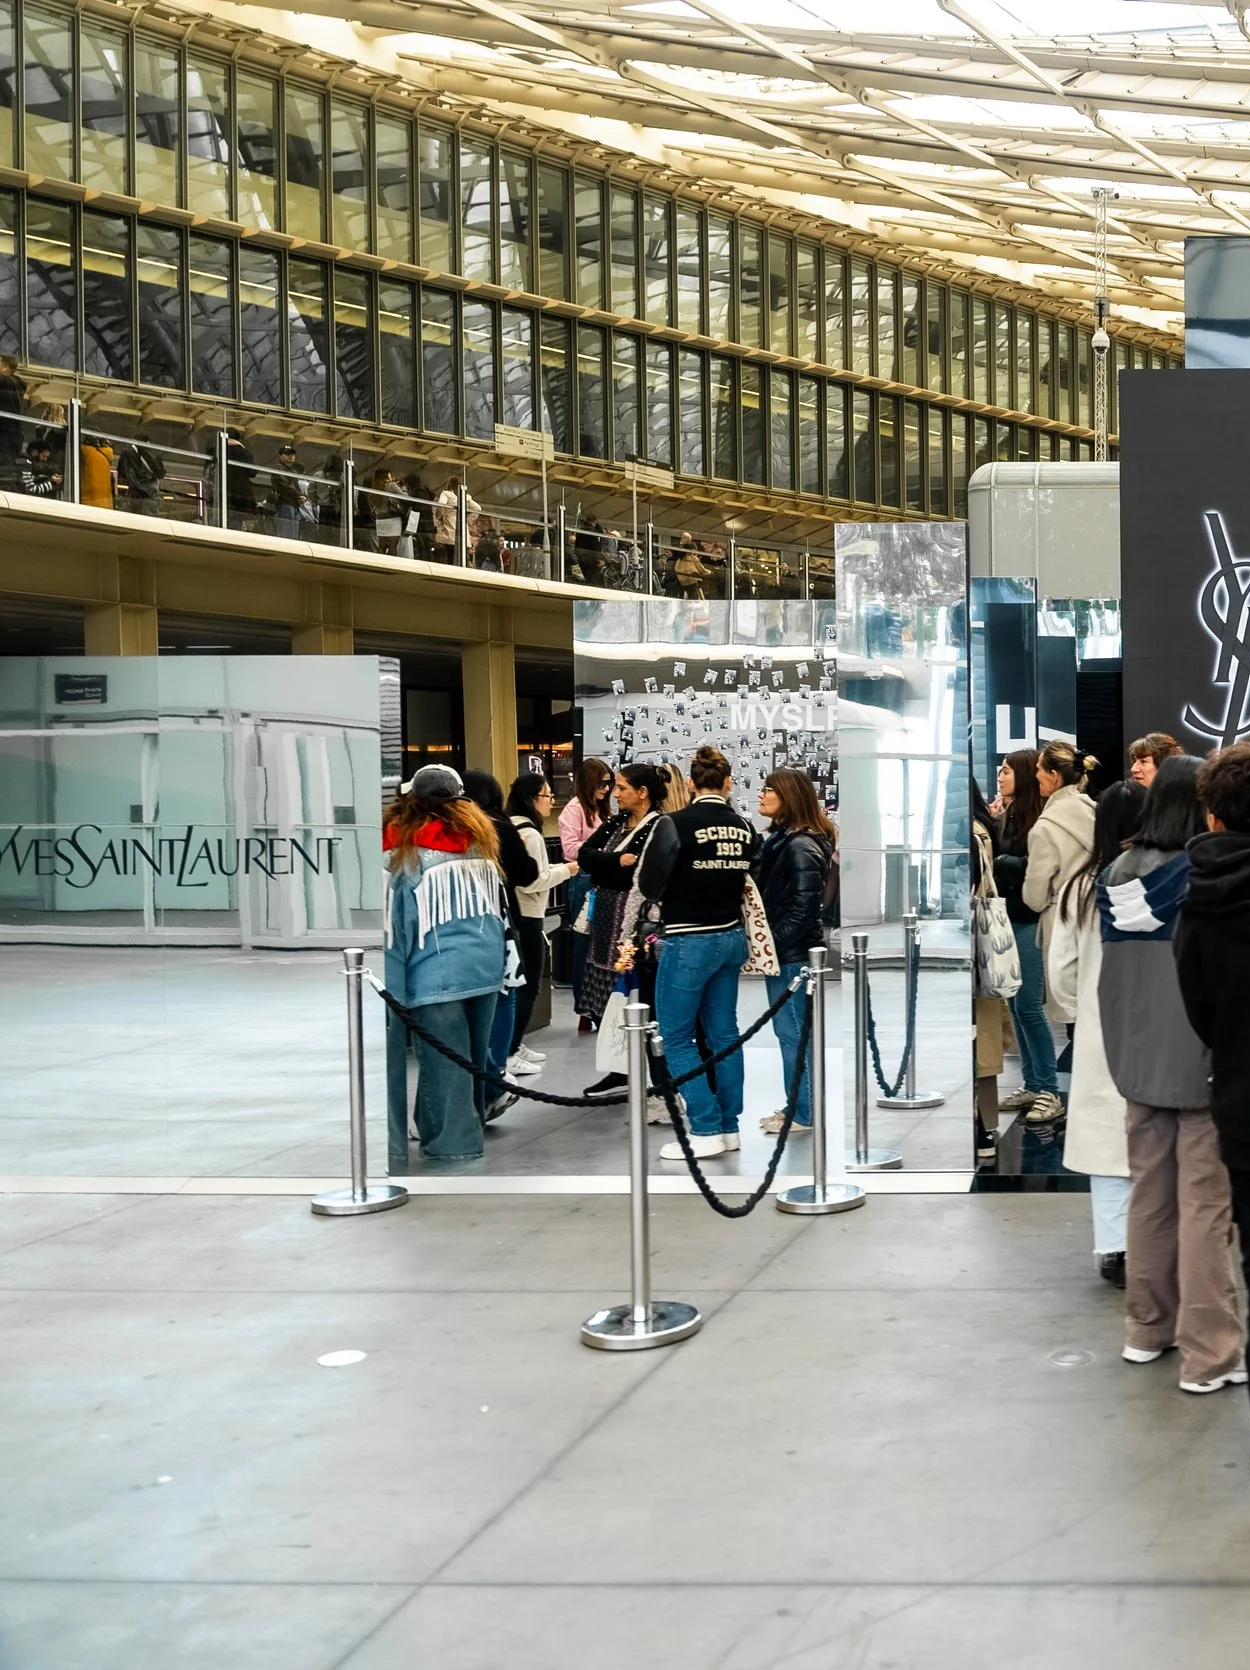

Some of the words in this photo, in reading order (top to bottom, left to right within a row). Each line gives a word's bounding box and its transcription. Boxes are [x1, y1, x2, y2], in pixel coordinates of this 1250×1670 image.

[694, 826, 752, 844] SCHOTT
[716, 842, 743, 856] 1913
[692, 860, 723, 869] SAINT
